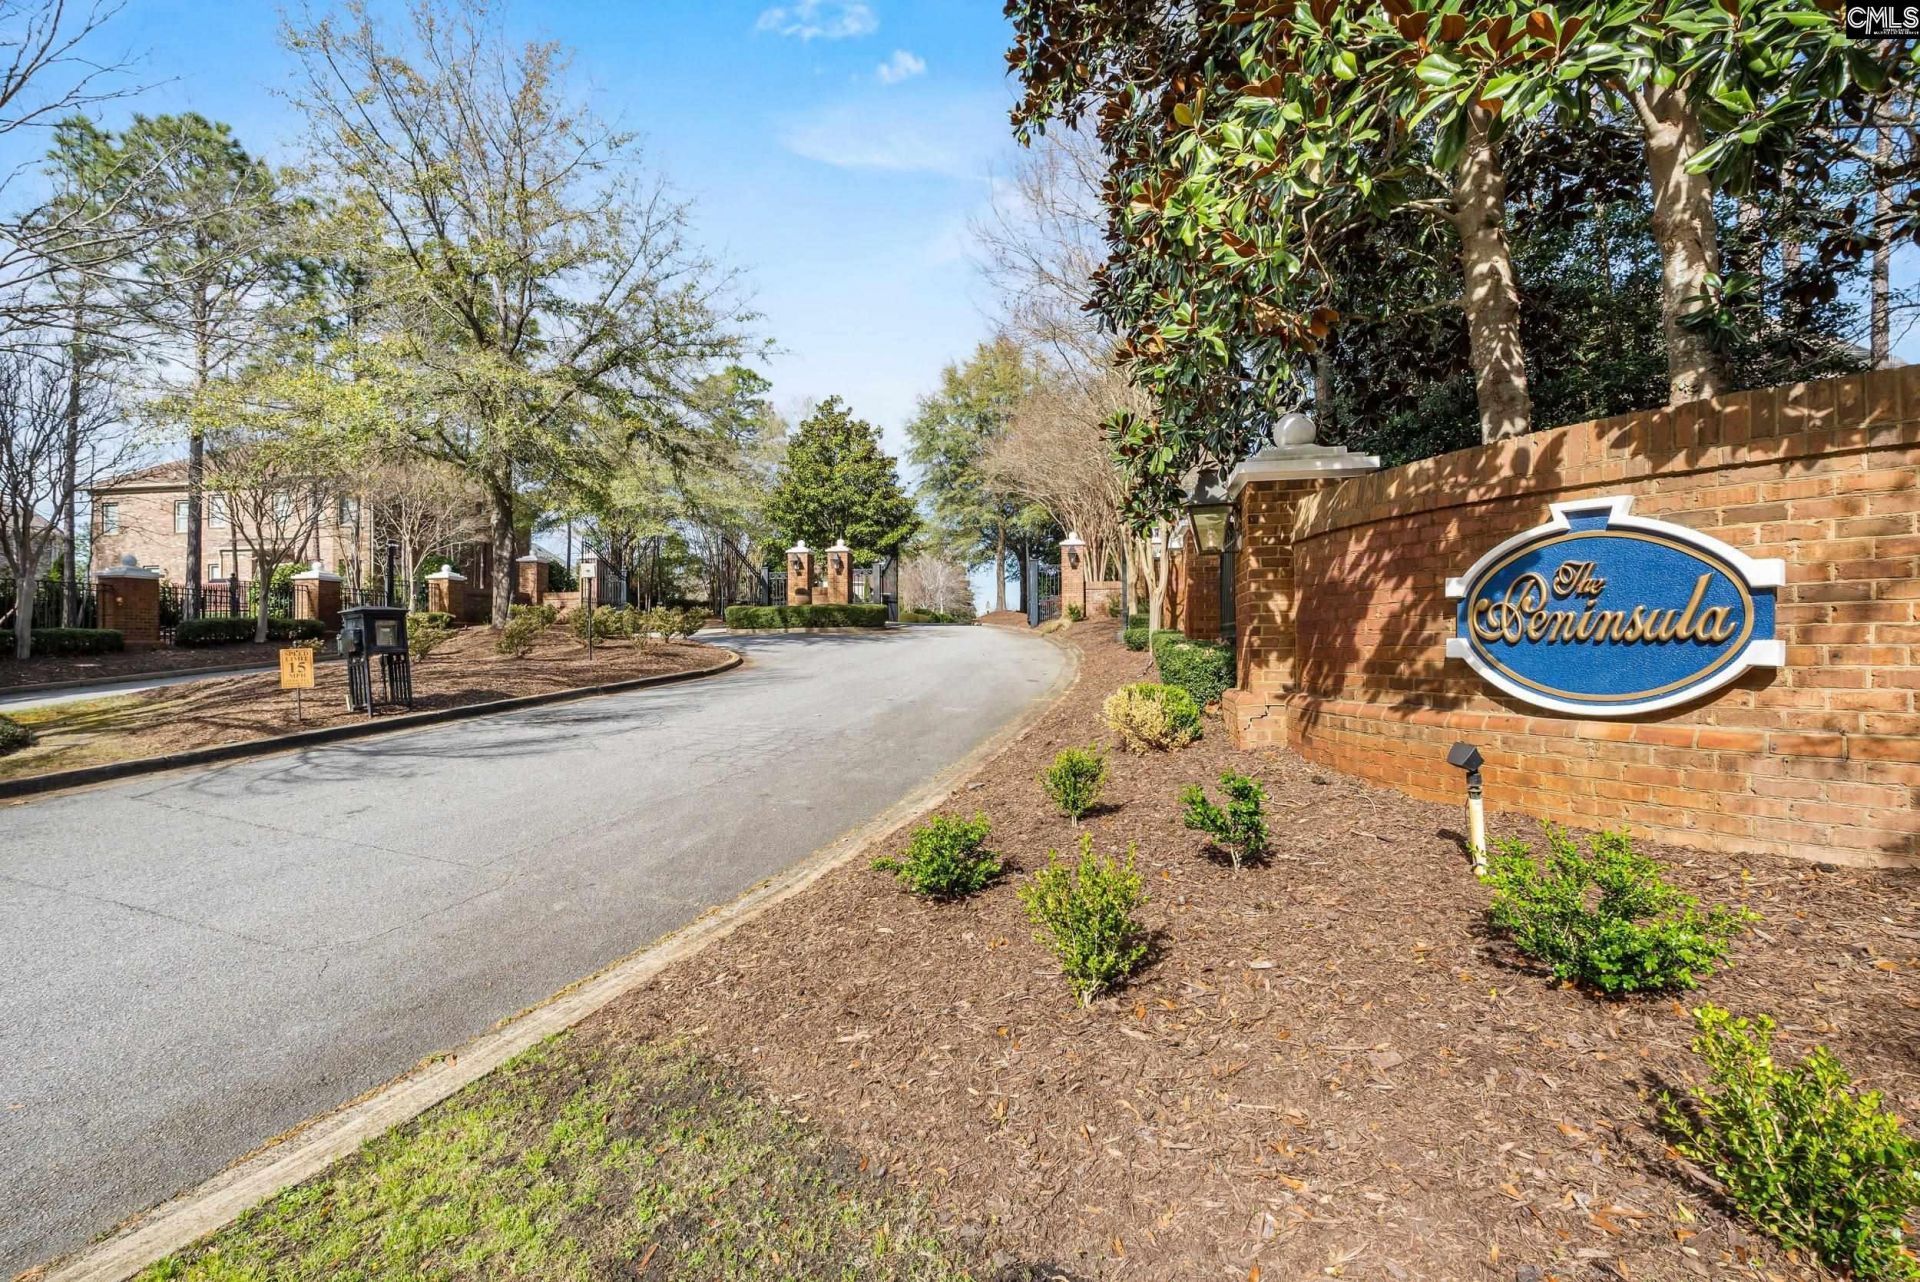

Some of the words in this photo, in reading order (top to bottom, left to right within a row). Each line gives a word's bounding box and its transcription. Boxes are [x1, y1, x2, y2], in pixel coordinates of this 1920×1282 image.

[1552, 560, 1607, 597] The
[1473, 572, 1736, 644] Peninsula
[289, 661, 306, 673] 15
